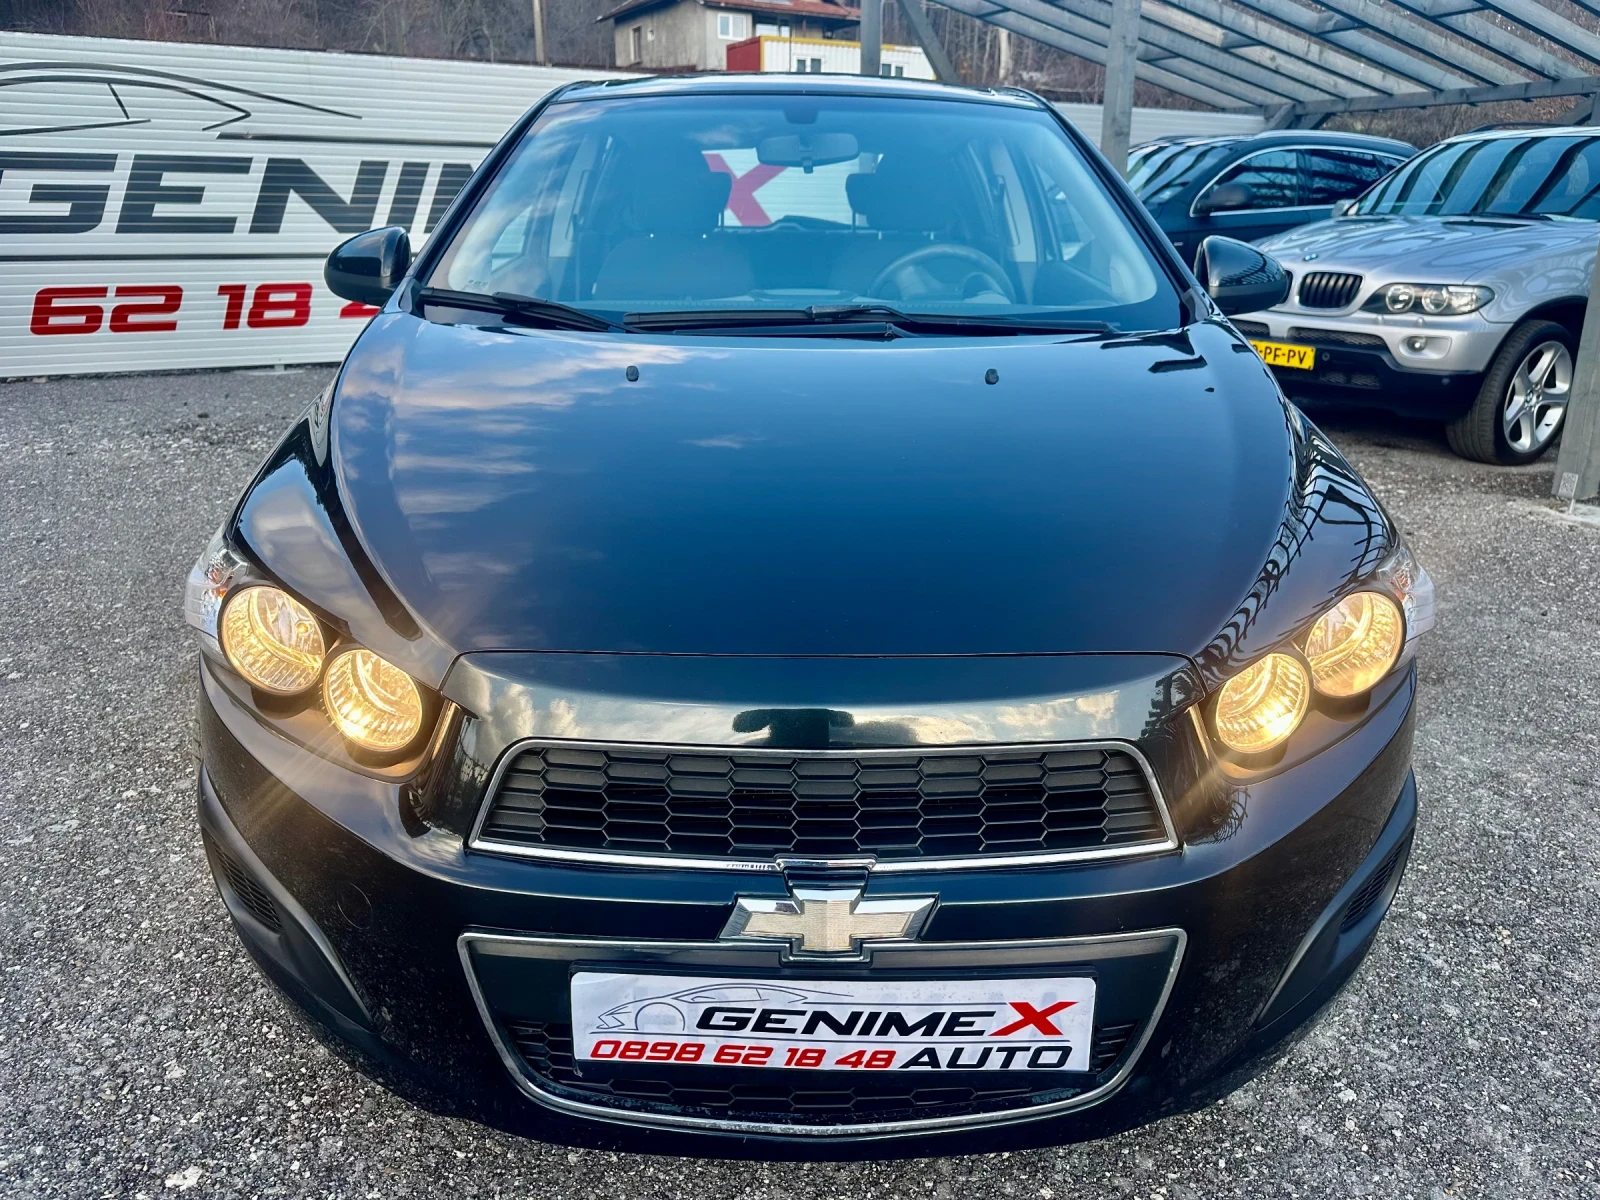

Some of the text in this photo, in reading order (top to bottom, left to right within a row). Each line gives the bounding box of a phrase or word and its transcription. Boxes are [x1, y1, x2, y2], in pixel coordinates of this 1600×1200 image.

[30, 282, 313, 335] 62 18
[696, 1001, 1079, 1037] GENIMEX
[590, 1040, 1073, 1070] 0898 62 18 48 AUTO
